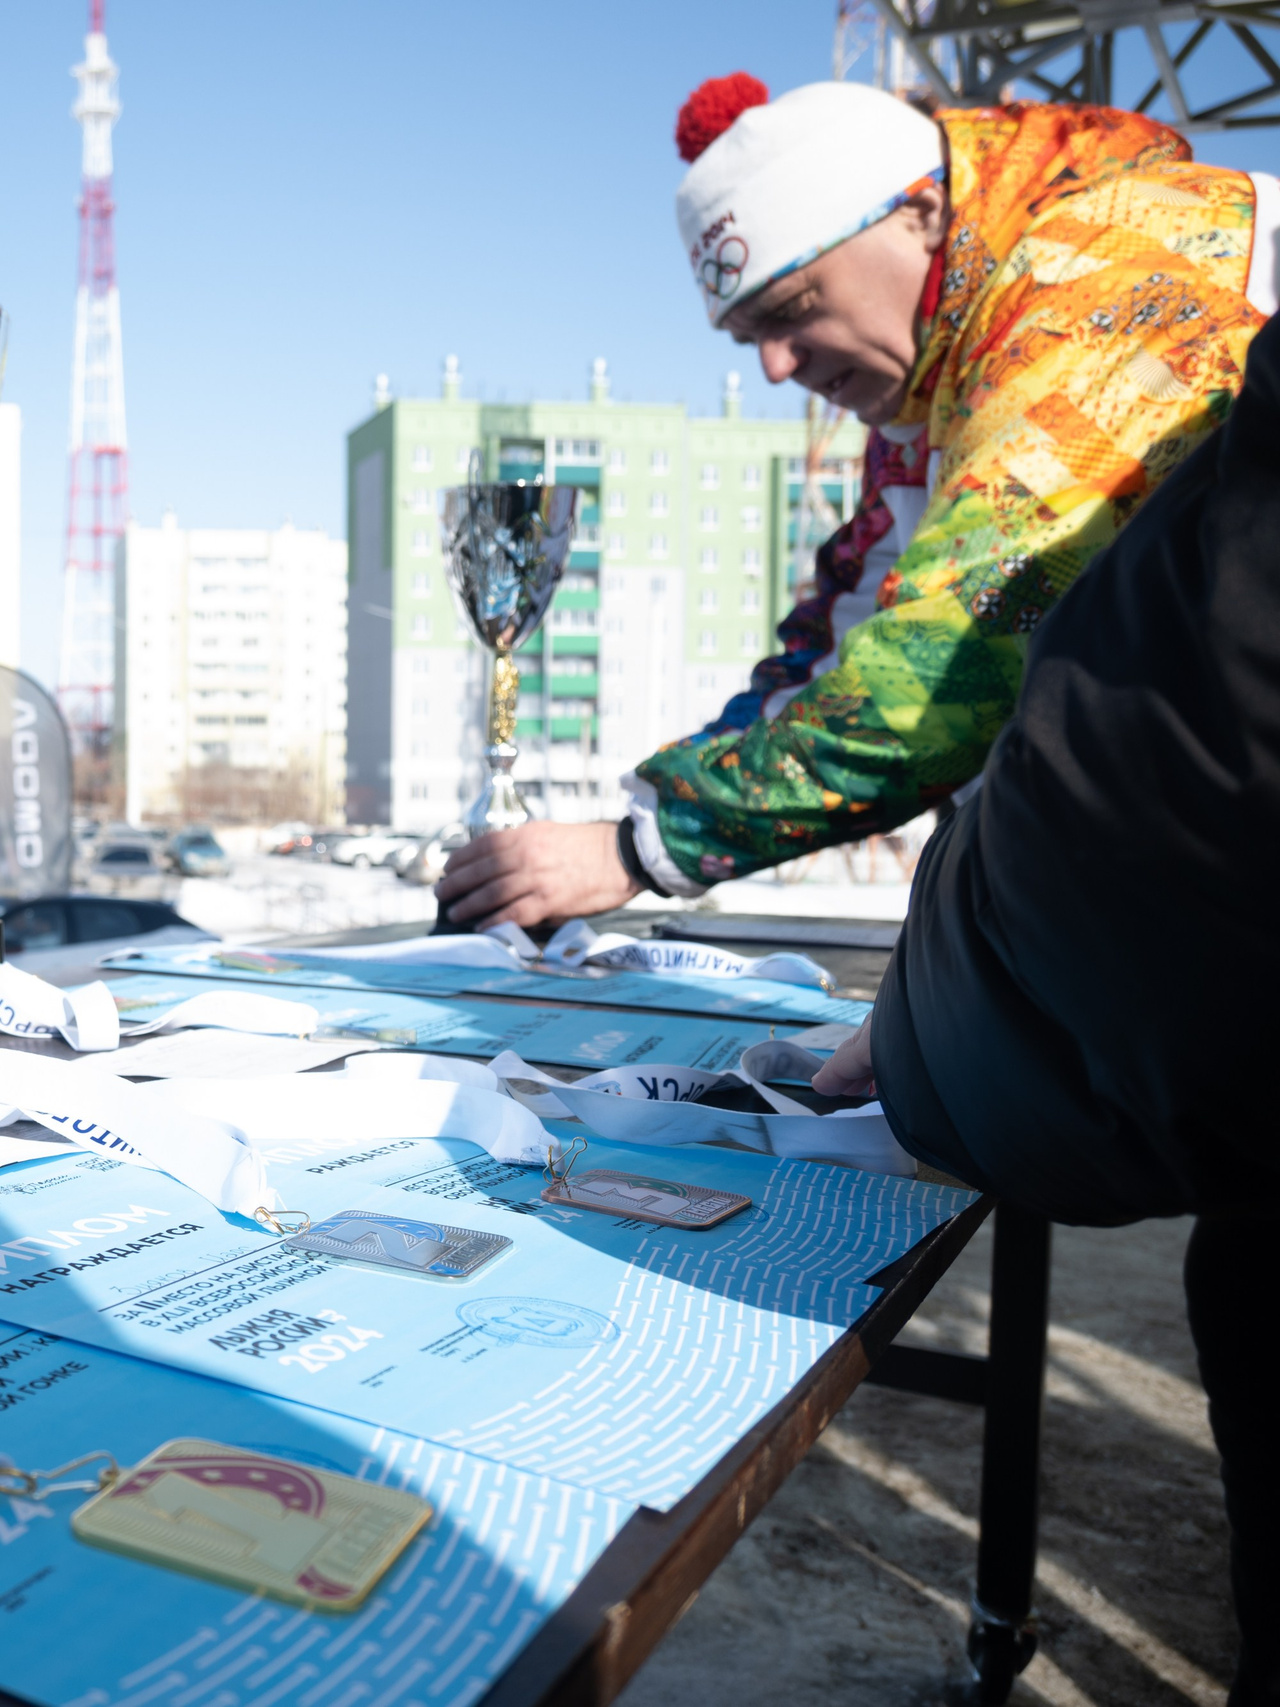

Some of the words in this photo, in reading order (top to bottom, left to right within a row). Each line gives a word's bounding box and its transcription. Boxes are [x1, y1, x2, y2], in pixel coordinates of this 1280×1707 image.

[306, 1140, 421, 1175] РАЖДАЕТСЯ
[113, 1310, 148, 1322] ЗА
[155, 1281, 213, 1305] МЕСТО
[208, 1271, 237, 1284] НА
[166, 1291, 265, 1334] МАССОВОЙ
[258, 1263, 331, 1295] ЛЫЖНОЙ
[140, 1318, 162, 1328] В
[208, 1309, 302, 1351] ЛЫЖНЯ
[237, 1316, 336, 1359] РОССИИ
[278, 1325, 384, 1374] 2024
[17, 1360, 89, 1396] ГОНКЕ
